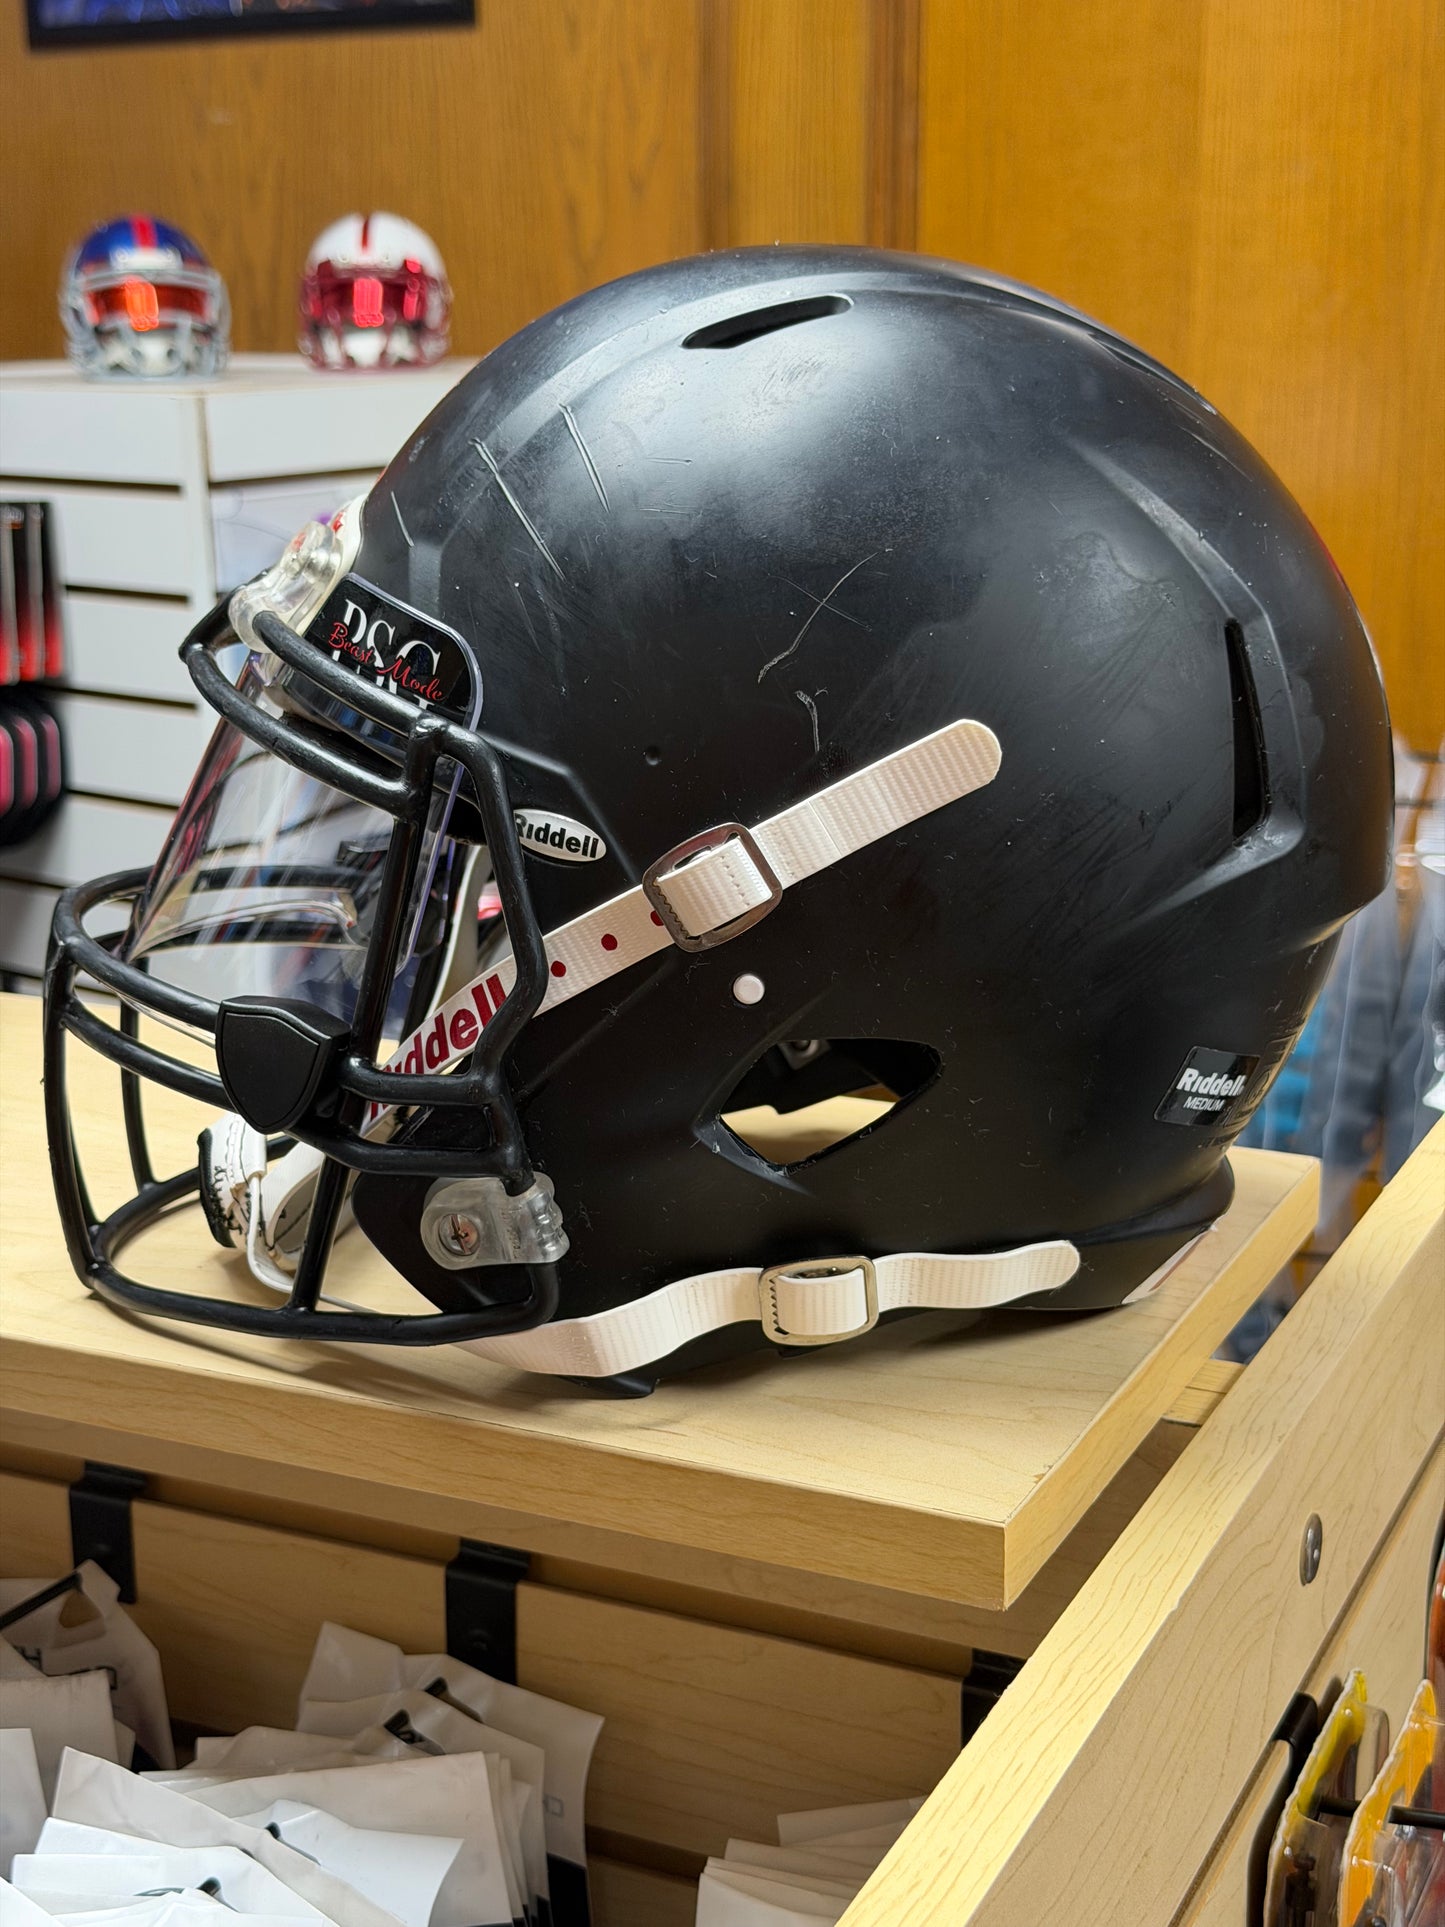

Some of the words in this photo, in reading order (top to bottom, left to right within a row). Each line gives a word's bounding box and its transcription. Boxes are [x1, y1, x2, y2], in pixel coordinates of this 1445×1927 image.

[328, 621, 377, 665] Beast
[376, 657, 446, 702] Mode
[514, 812, 599, 858] Riddell
[1176, 1067, 1246, 1097] Riddell
[1183, 1096, 1225, 1112] MEDIUM
